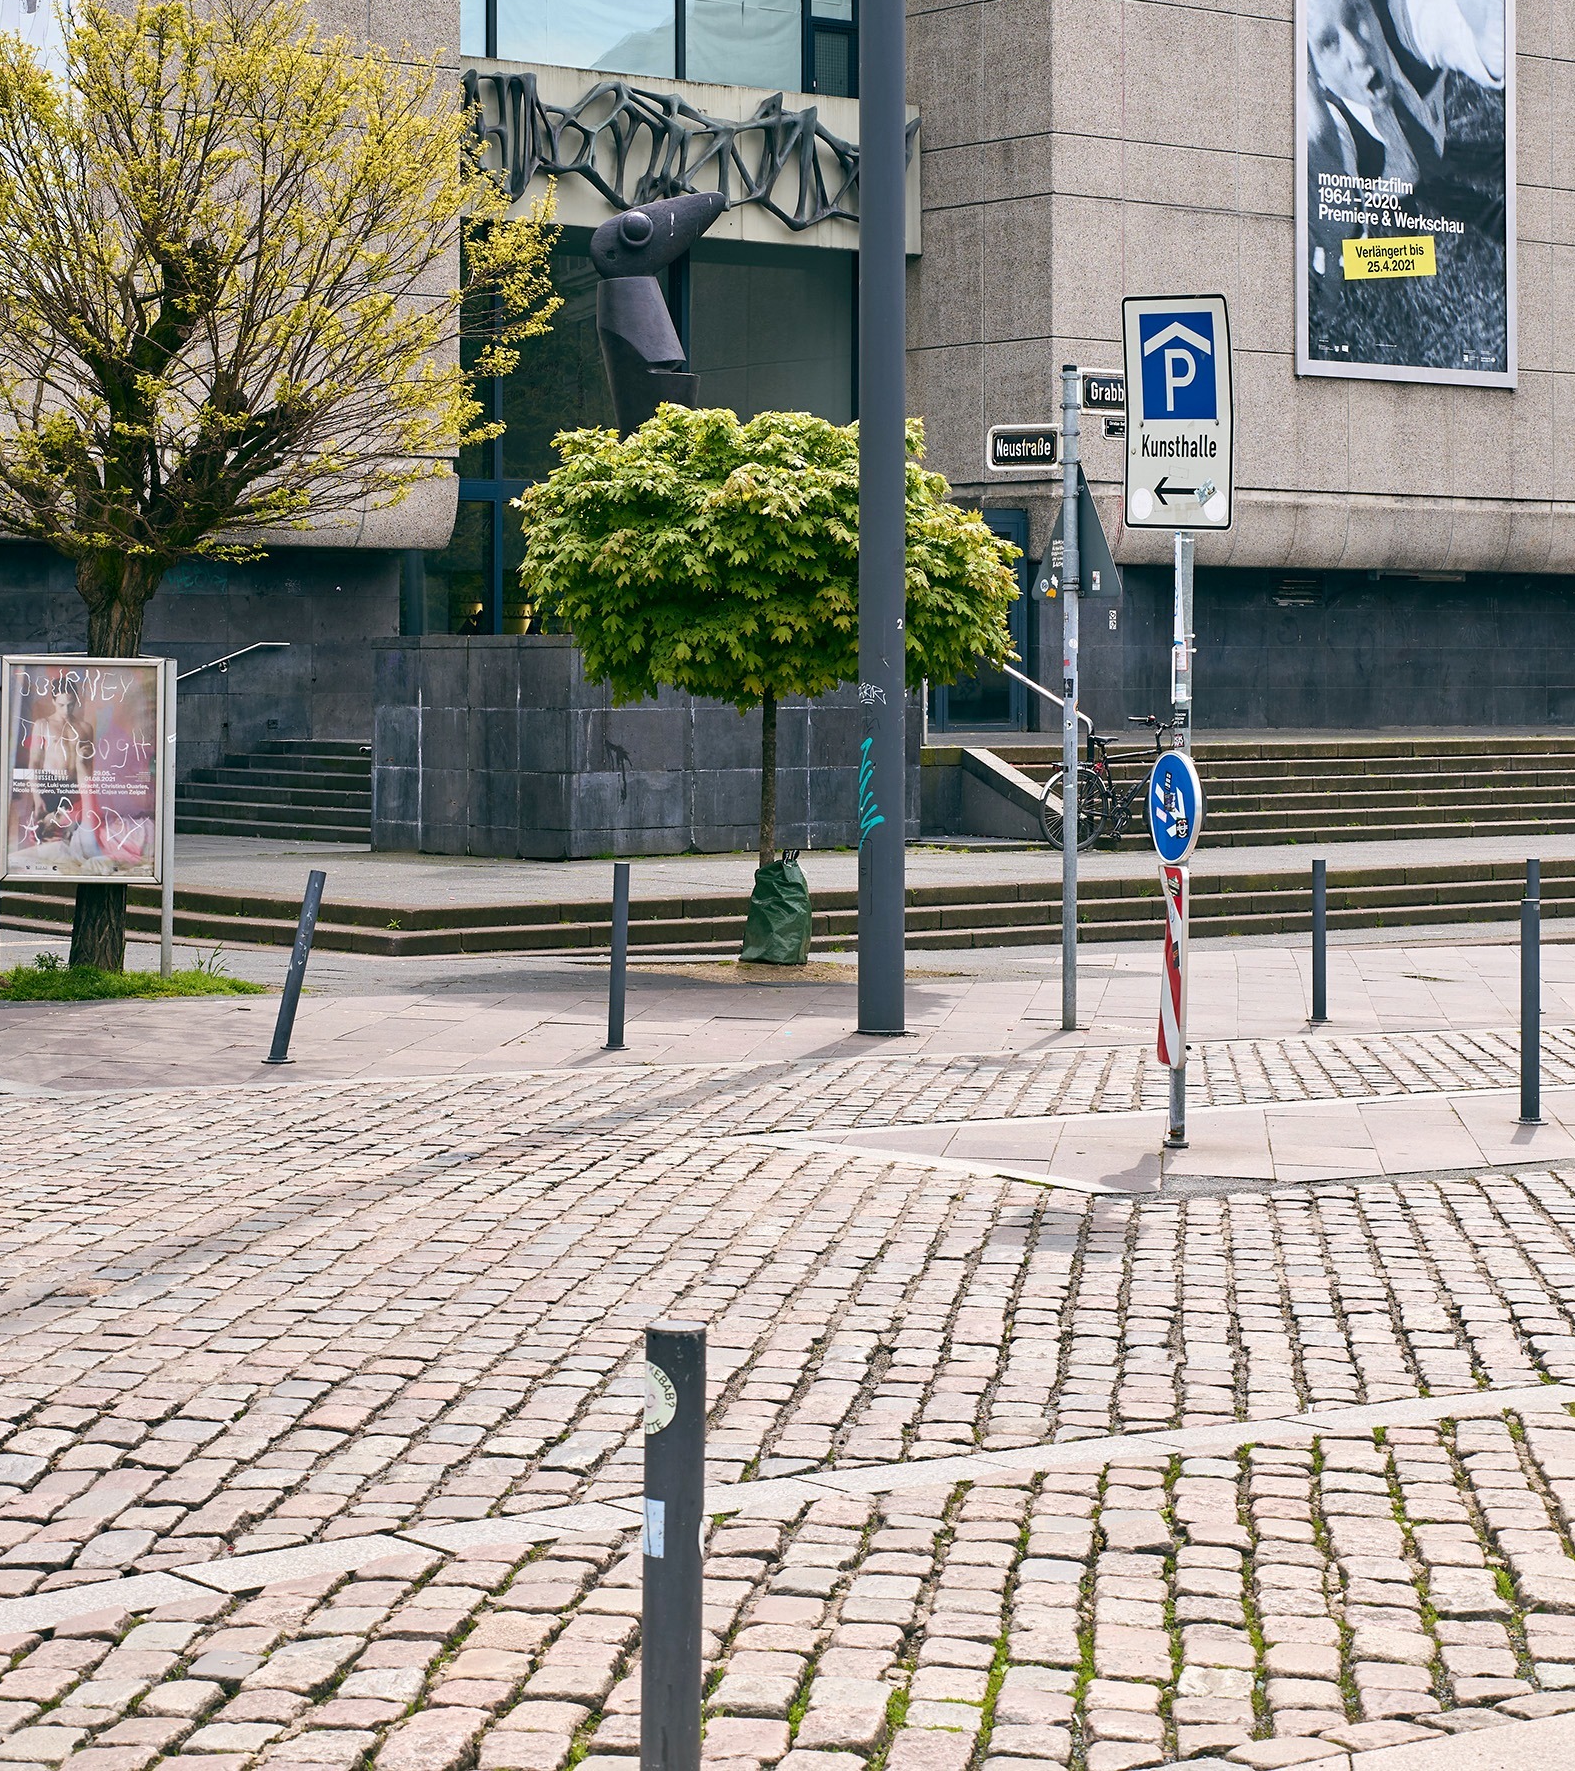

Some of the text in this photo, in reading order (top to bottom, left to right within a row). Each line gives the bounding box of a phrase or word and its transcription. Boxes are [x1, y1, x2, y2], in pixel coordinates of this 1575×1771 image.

[1318, 172, 1414, 195] mommartzfilm
[1318, 186, 1352, 205] 1964
[1364, 193, 1402, 211] 2020.
[1318, 203, 1465, 234] Premiere & Werkschau
[1355, 243, 1425, 259] Verlängert bis
[1367, 259, 1416, 273] 25.4.2021
[1164, 348, 1196, 412] P
[996, 438, 1052, 457] Neustraße
[1141, 434, 1217, 458] Kunsthalle
[897, 618, 903, 630] 2
[13, 668, 134, 708] JOURNEY
[50, 797, 150, 850] BODY
